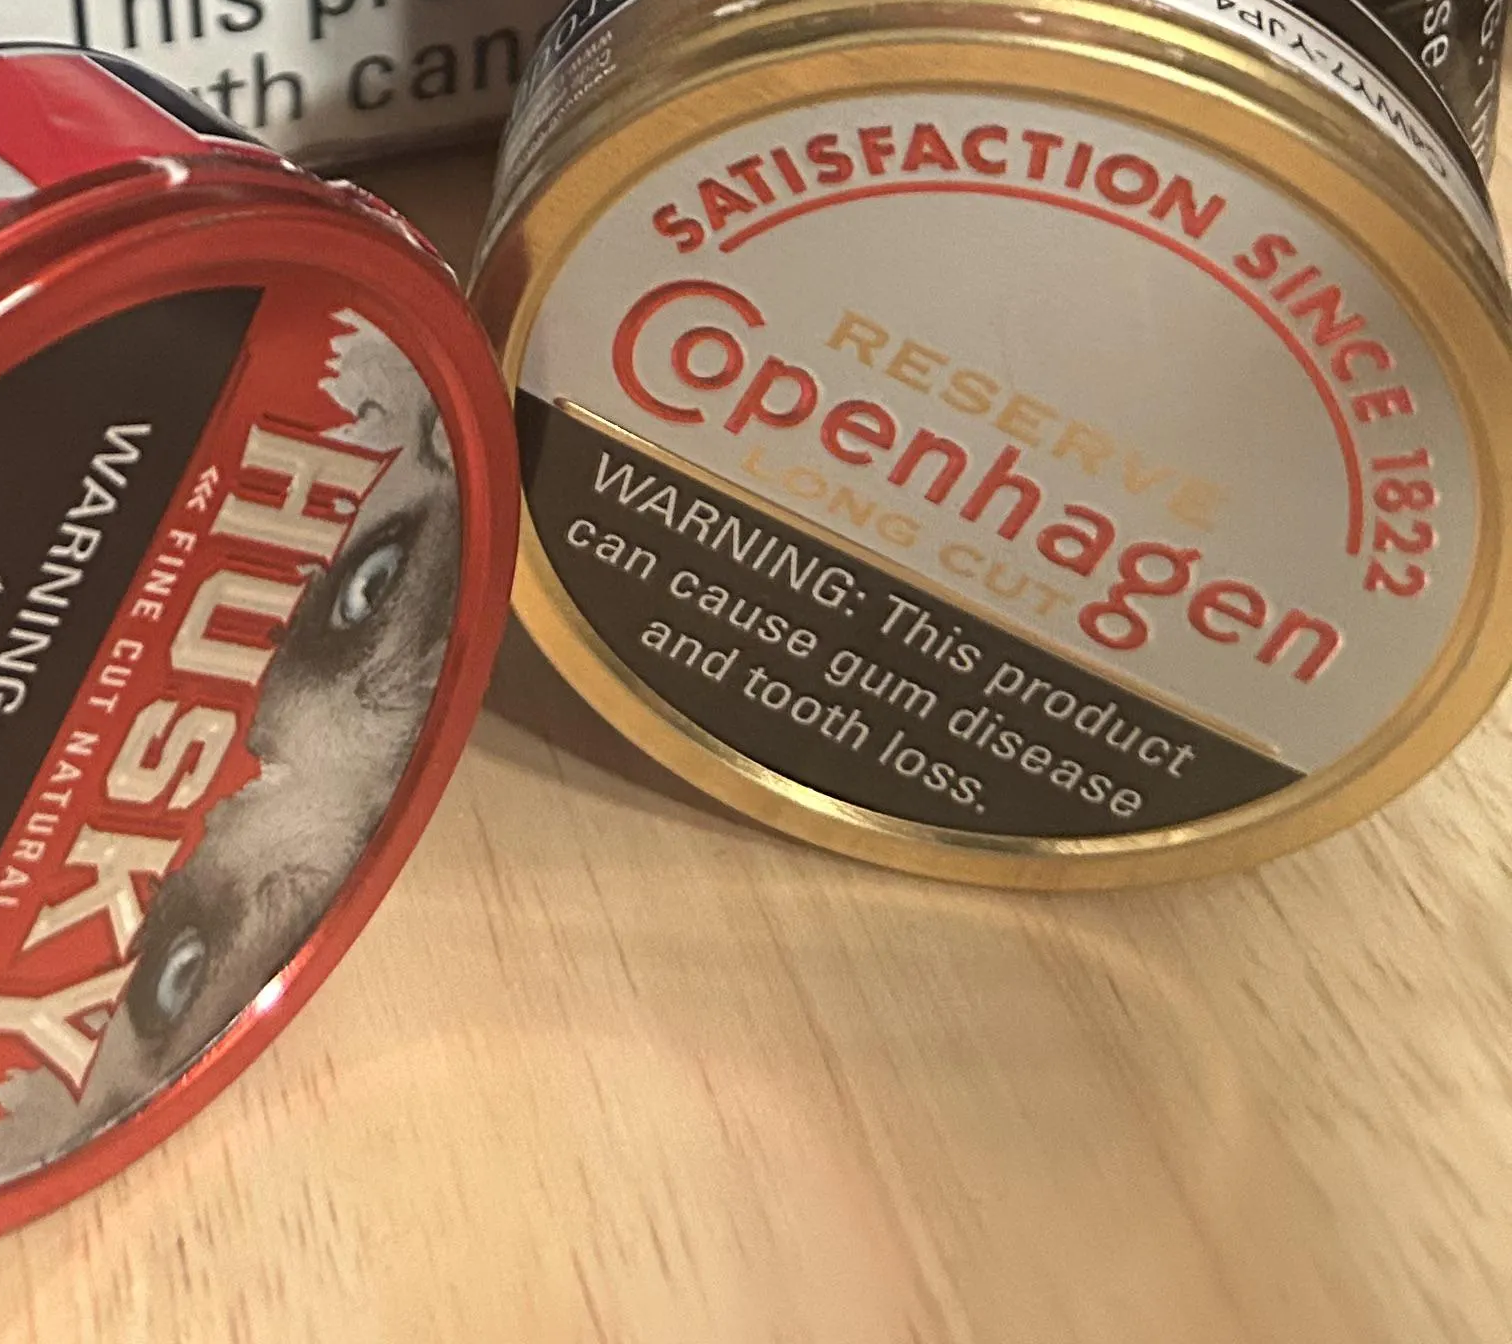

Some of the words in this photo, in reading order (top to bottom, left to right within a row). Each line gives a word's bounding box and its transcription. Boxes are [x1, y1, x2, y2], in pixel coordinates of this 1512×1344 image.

[653, 123, 1227, 255] SATISFACTION
[1234, 233, 1414, 423] SINCE
[1363, 446, 1438, 600] 1822
[824, 310, 1226, 532] RESERVE
[129, 527, 199, 624] FINE
[612, 279, 1344, 685] Copenhagen
[740, 443, 918, 550] LONG
[938, 541, 1074, 622] CUT
[88, 638, 146, 715] CUT
[565, 514, 657, 584] can
[667, 563, 820, 660] cause
[824, 643, 938, 723] gum
[947, 700, 1144, 821] disease
[593, 449, 869, 619] WARNING:
[885, 593, 984, 674] This
[985, 660, 1197, 780] product
[640, 612, 734, 684] and
[741, 658, 874, 753] tooth
[877, 724, 990, 816] loss.
